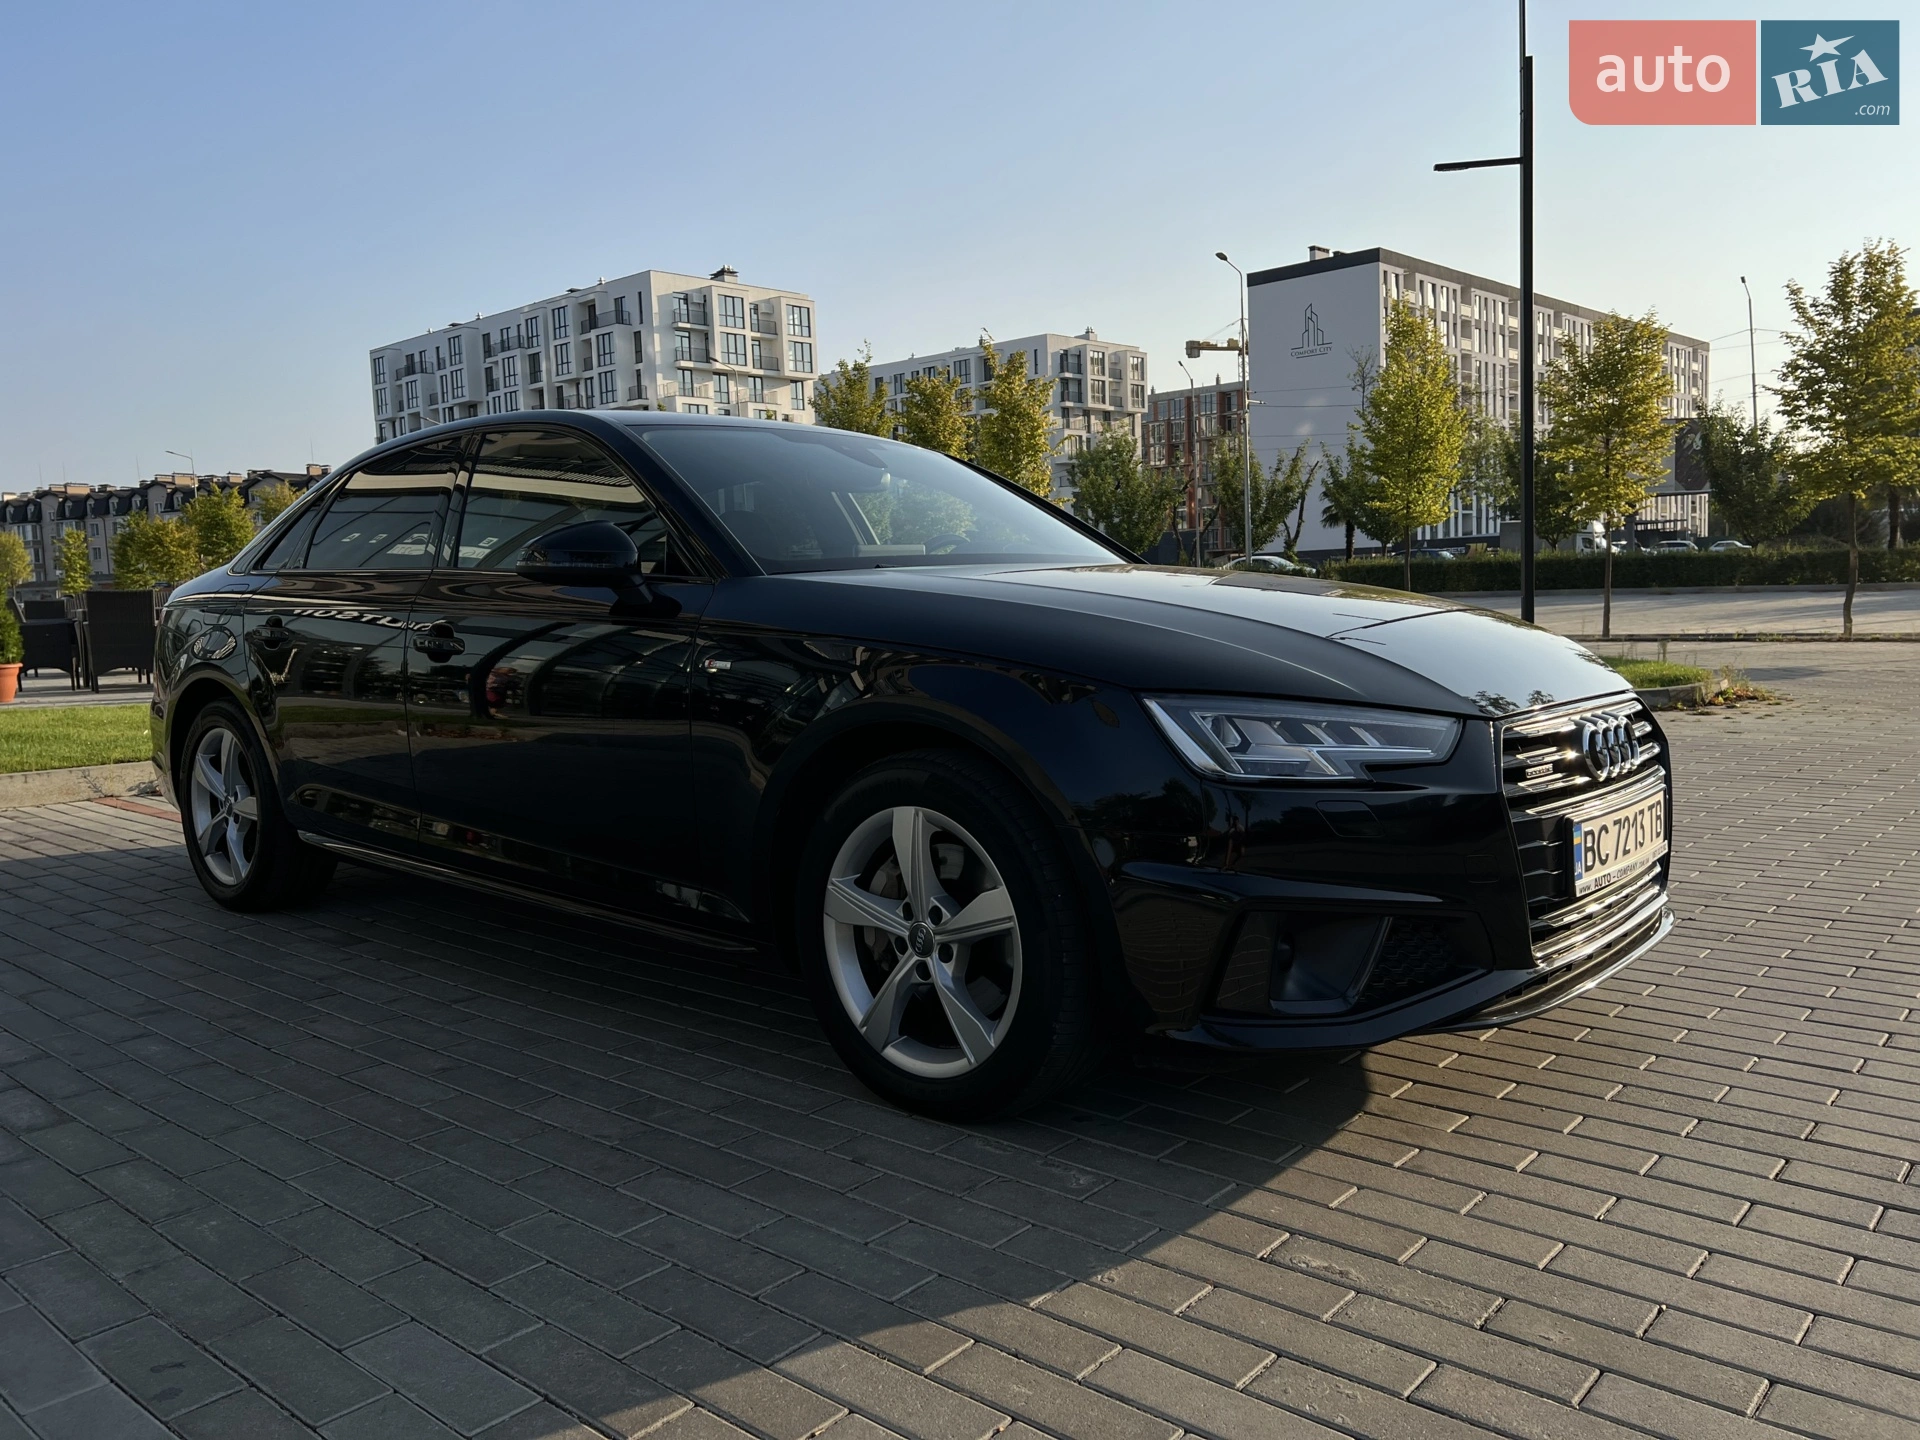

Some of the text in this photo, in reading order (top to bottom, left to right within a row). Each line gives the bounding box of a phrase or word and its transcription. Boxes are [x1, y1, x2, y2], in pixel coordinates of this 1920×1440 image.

[1583, 800, 1662, 873] BC 7213 TB
